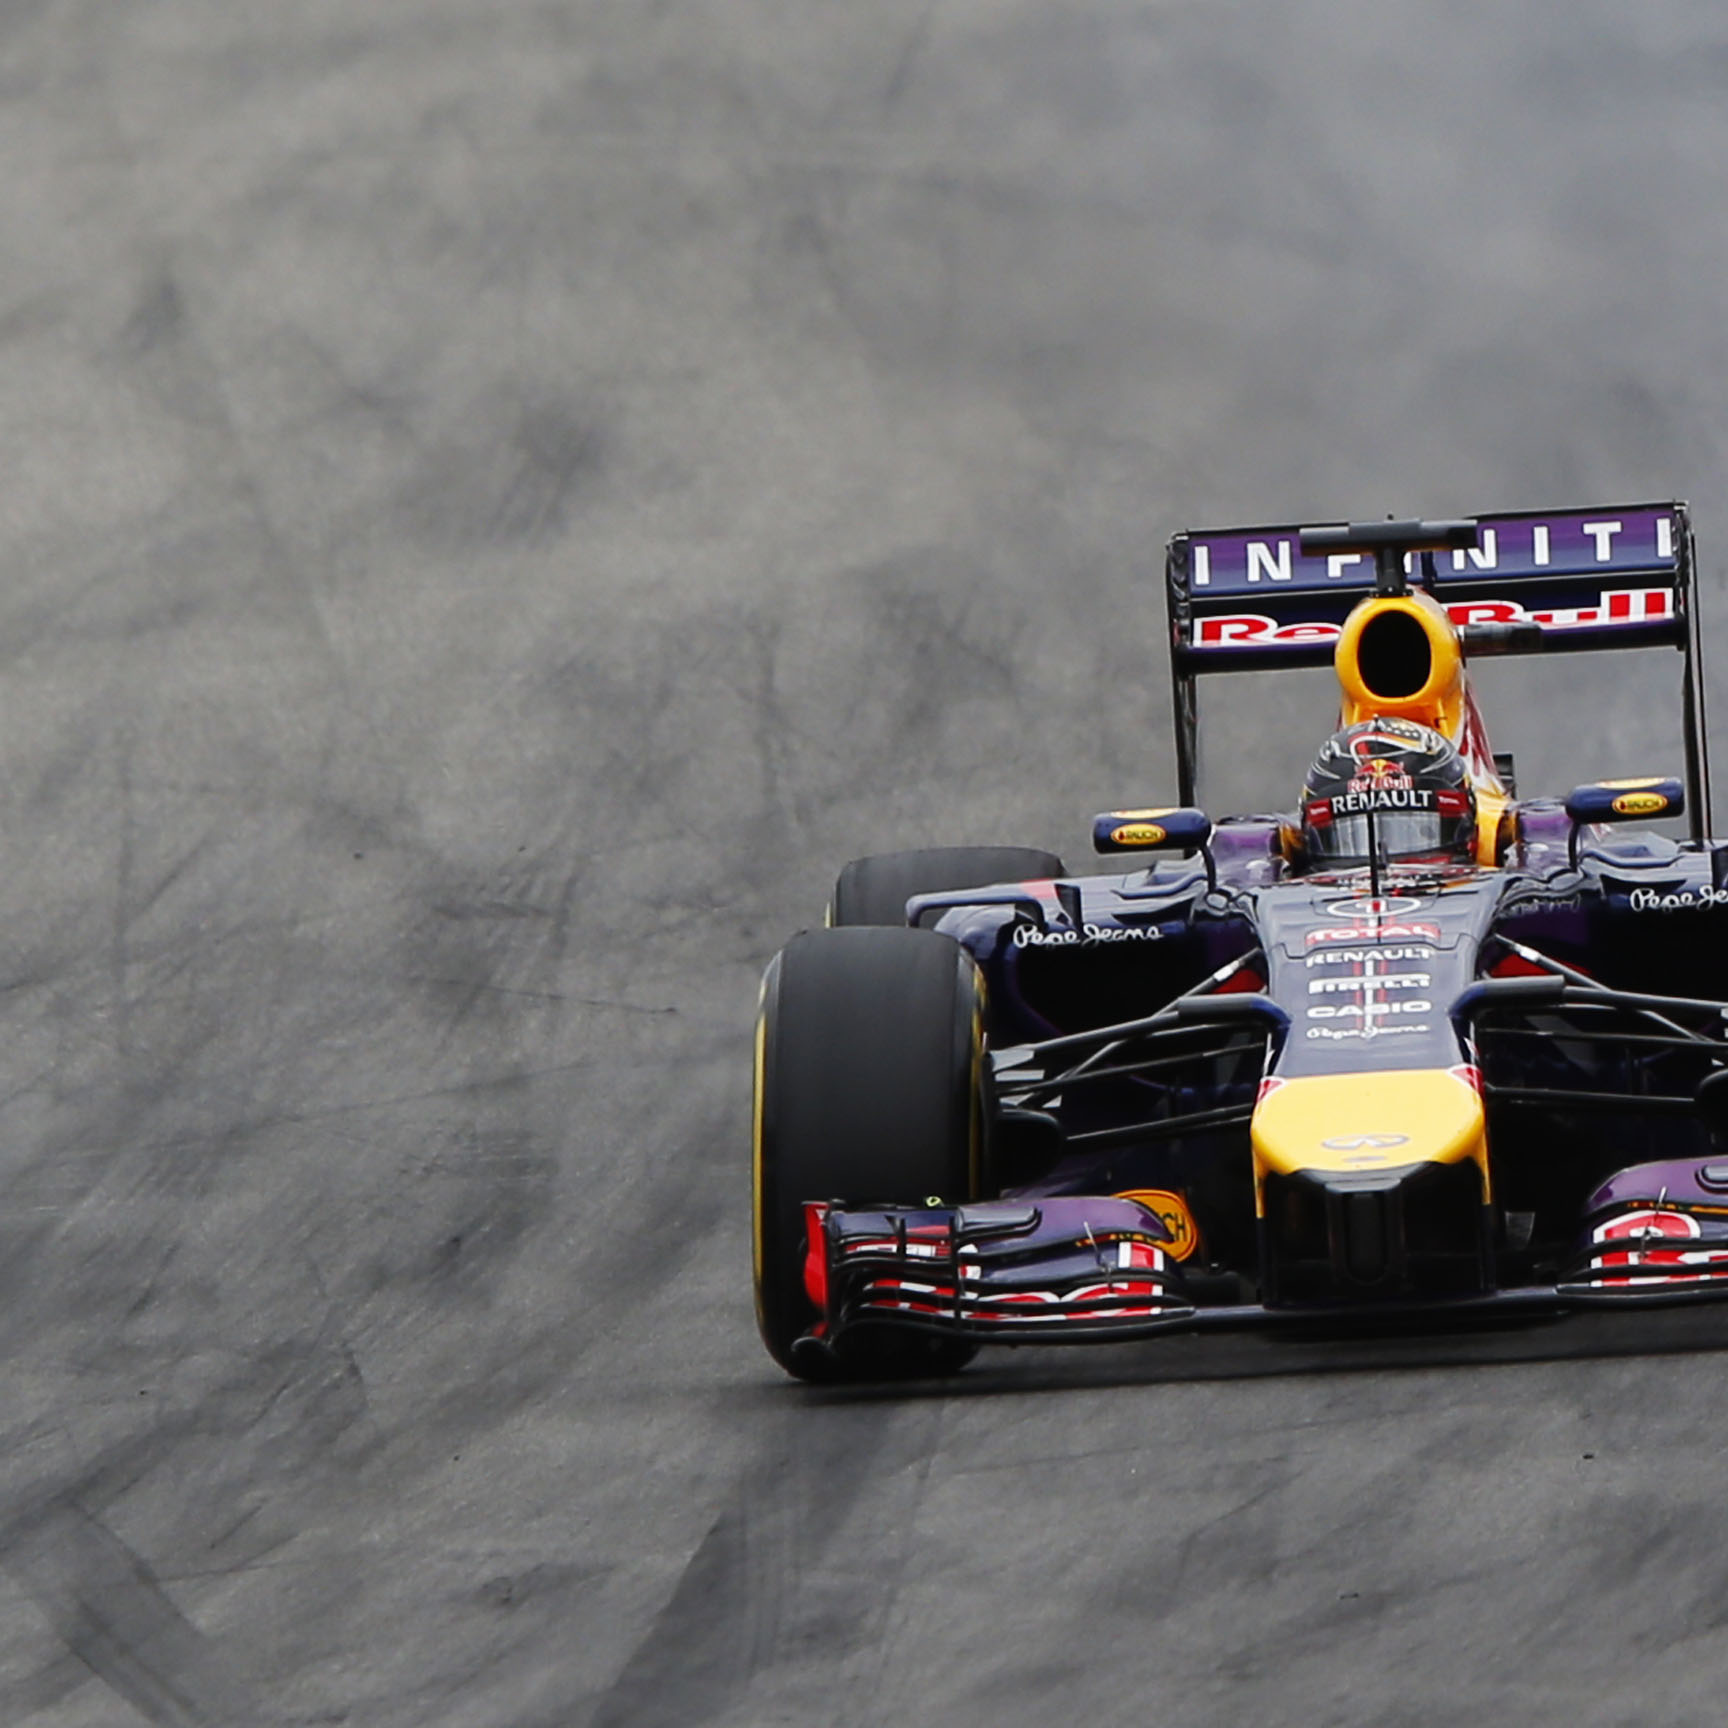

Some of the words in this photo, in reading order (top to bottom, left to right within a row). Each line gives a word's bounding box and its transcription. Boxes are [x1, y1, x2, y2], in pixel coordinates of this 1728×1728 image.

[1193, 613, 1343, 648] Re
[1331, 790, 1433, 814] RENAULT
[1630, 888, 1697, 913] Pepe
[1013, 925, 1080, 949] Pepe
[1080, 924, 1165, 948] Jeans
[1306, 925, 1437, 943] TOTAL
[1305, 947, 1437, 969] RENAULT
[1306, 1000, 1433, 1019] CASIO
